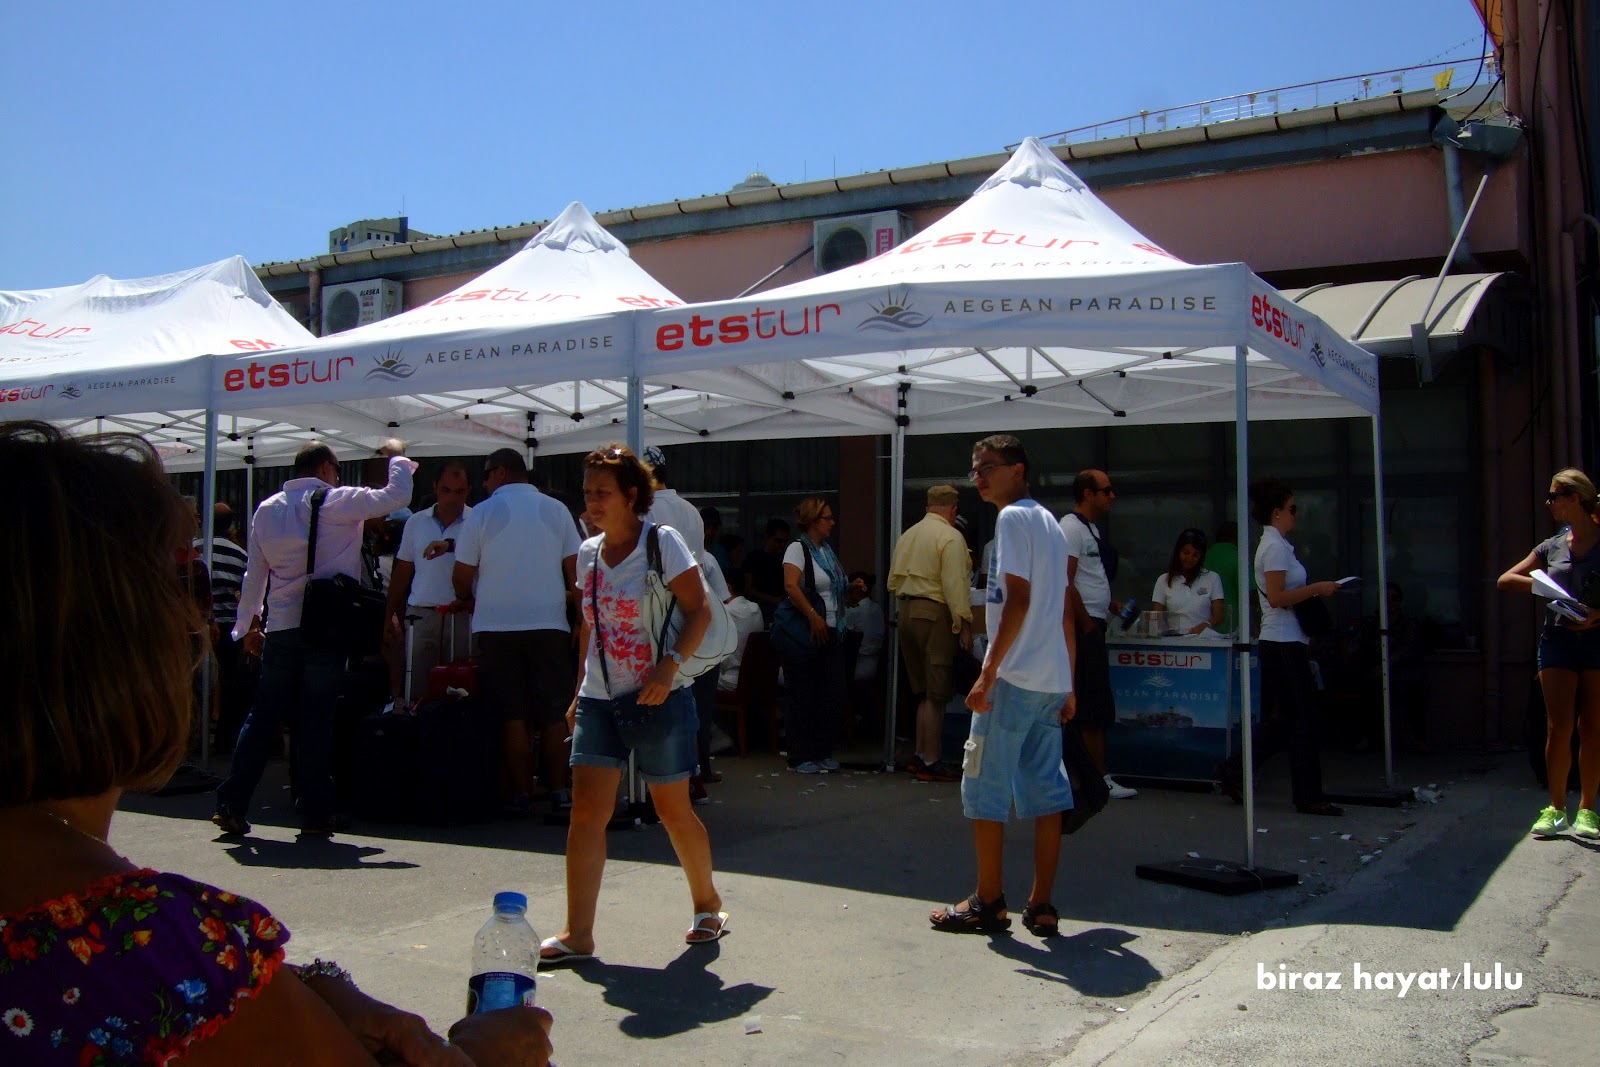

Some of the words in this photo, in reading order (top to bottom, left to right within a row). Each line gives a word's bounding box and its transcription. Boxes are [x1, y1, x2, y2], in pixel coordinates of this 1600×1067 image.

[360, 288, 380, 297] ALASKA
[655, 302, 841, 352] etstur
[943, 297, 1053, 315] AEGEAN
[1069, 294, 1217, 312] PARADISE
[1251, 293, 1306, 350] etstur
[224, 355, 354, 392] etstur
[425, 347, 501, 364] AEGEAN
[511, 336, 614, 356] PARADISE
[87, 380, 125, 391] AEGEAN
[127, 376, 176, 387] PARADISE
[1118, 651, 1203, 667] etstur
[1156, 691, 1219, 701] PARADISE
